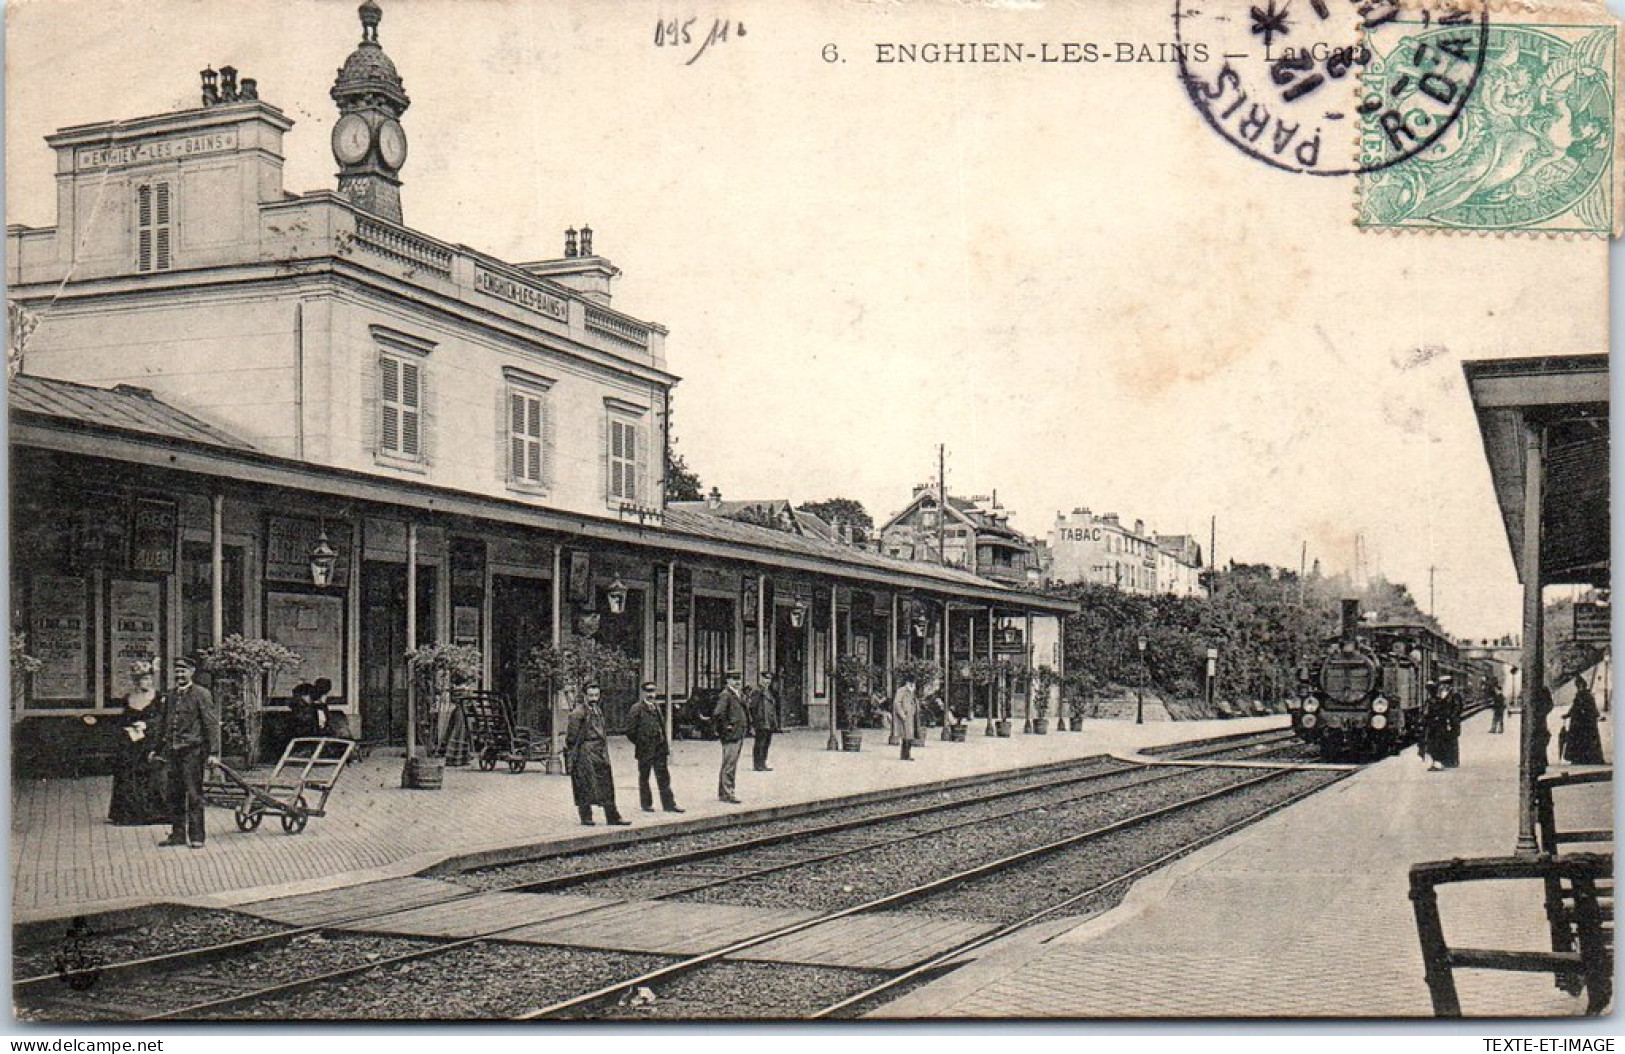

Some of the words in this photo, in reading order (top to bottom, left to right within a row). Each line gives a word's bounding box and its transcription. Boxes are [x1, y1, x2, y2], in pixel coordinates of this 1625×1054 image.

[821, 43, 847, 63] 6.
[875, 42, 1210, 63] ENGHIEN-LES-BAINS
[1264, 42, 1296, 62] La
[1199, 63, 1321, 166] PARIS
[1059, 527, 1101, 541] TABAC
